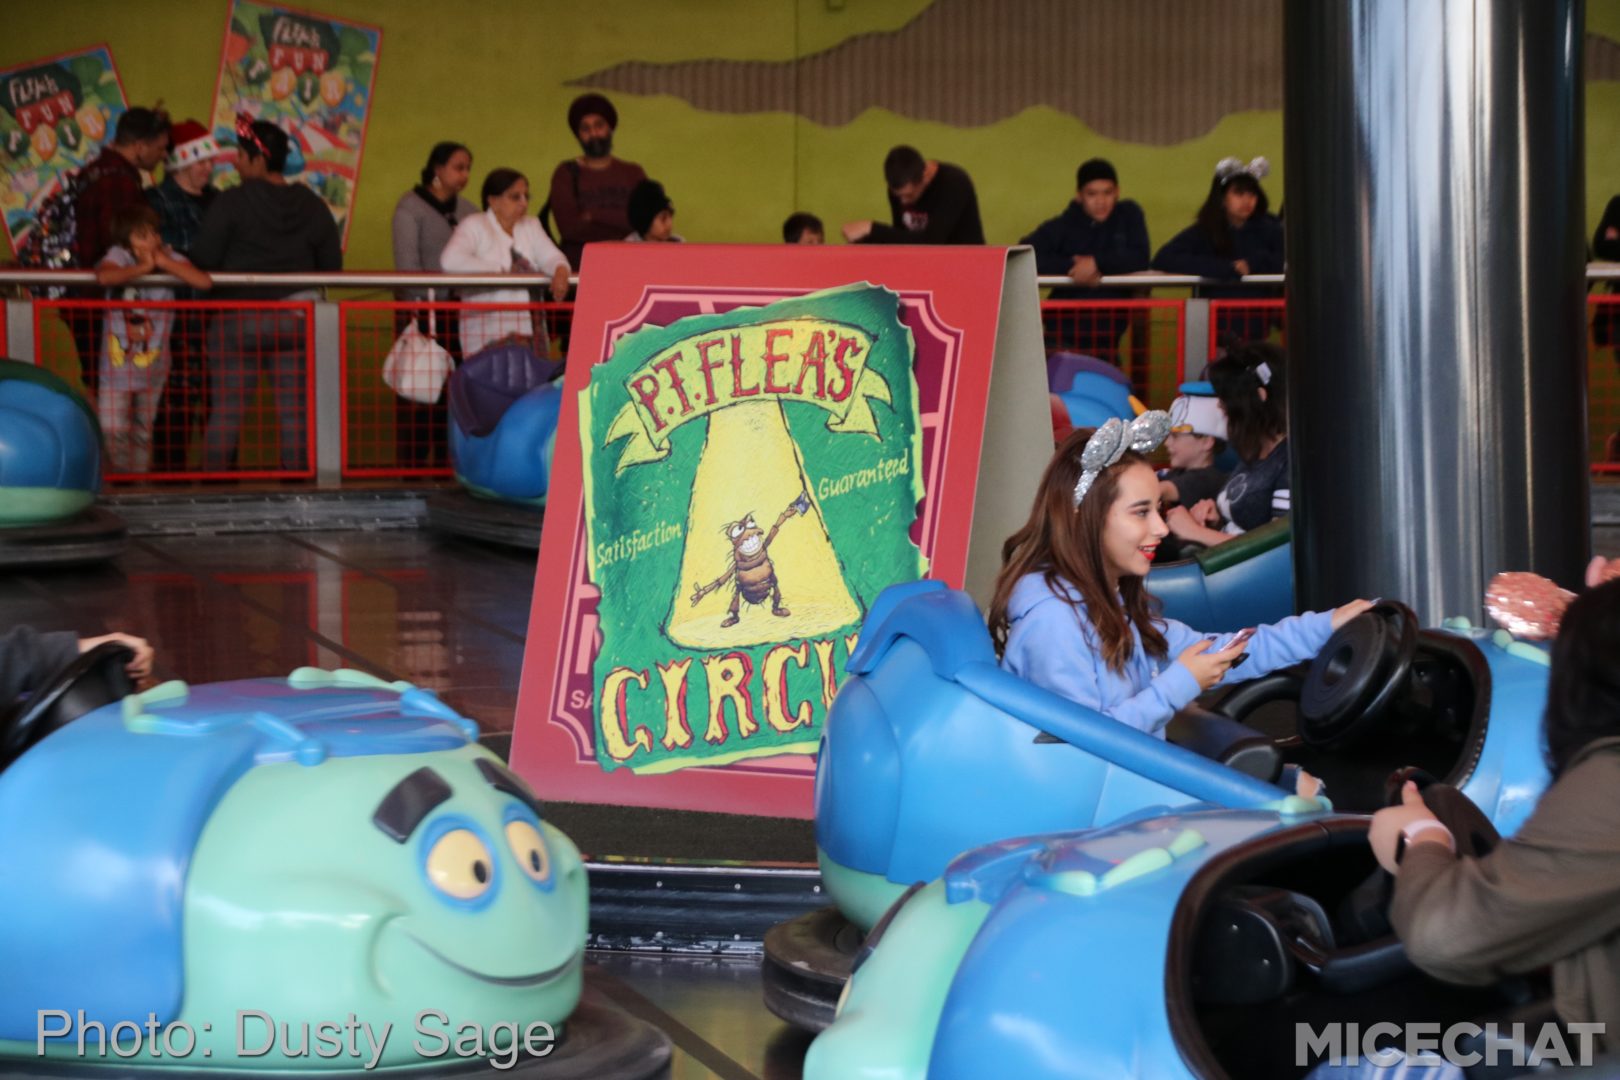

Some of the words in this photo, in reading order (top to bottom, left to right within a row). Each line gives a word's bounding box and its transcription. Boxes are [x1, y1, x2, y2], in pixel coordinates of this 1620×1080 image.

[274, 47, 325, 71] FUN
[21, 95, 73, 131] FUN
[818, 455, 909, 501] Guaranteed
[596, 521, 682, 568] Satisfaction
